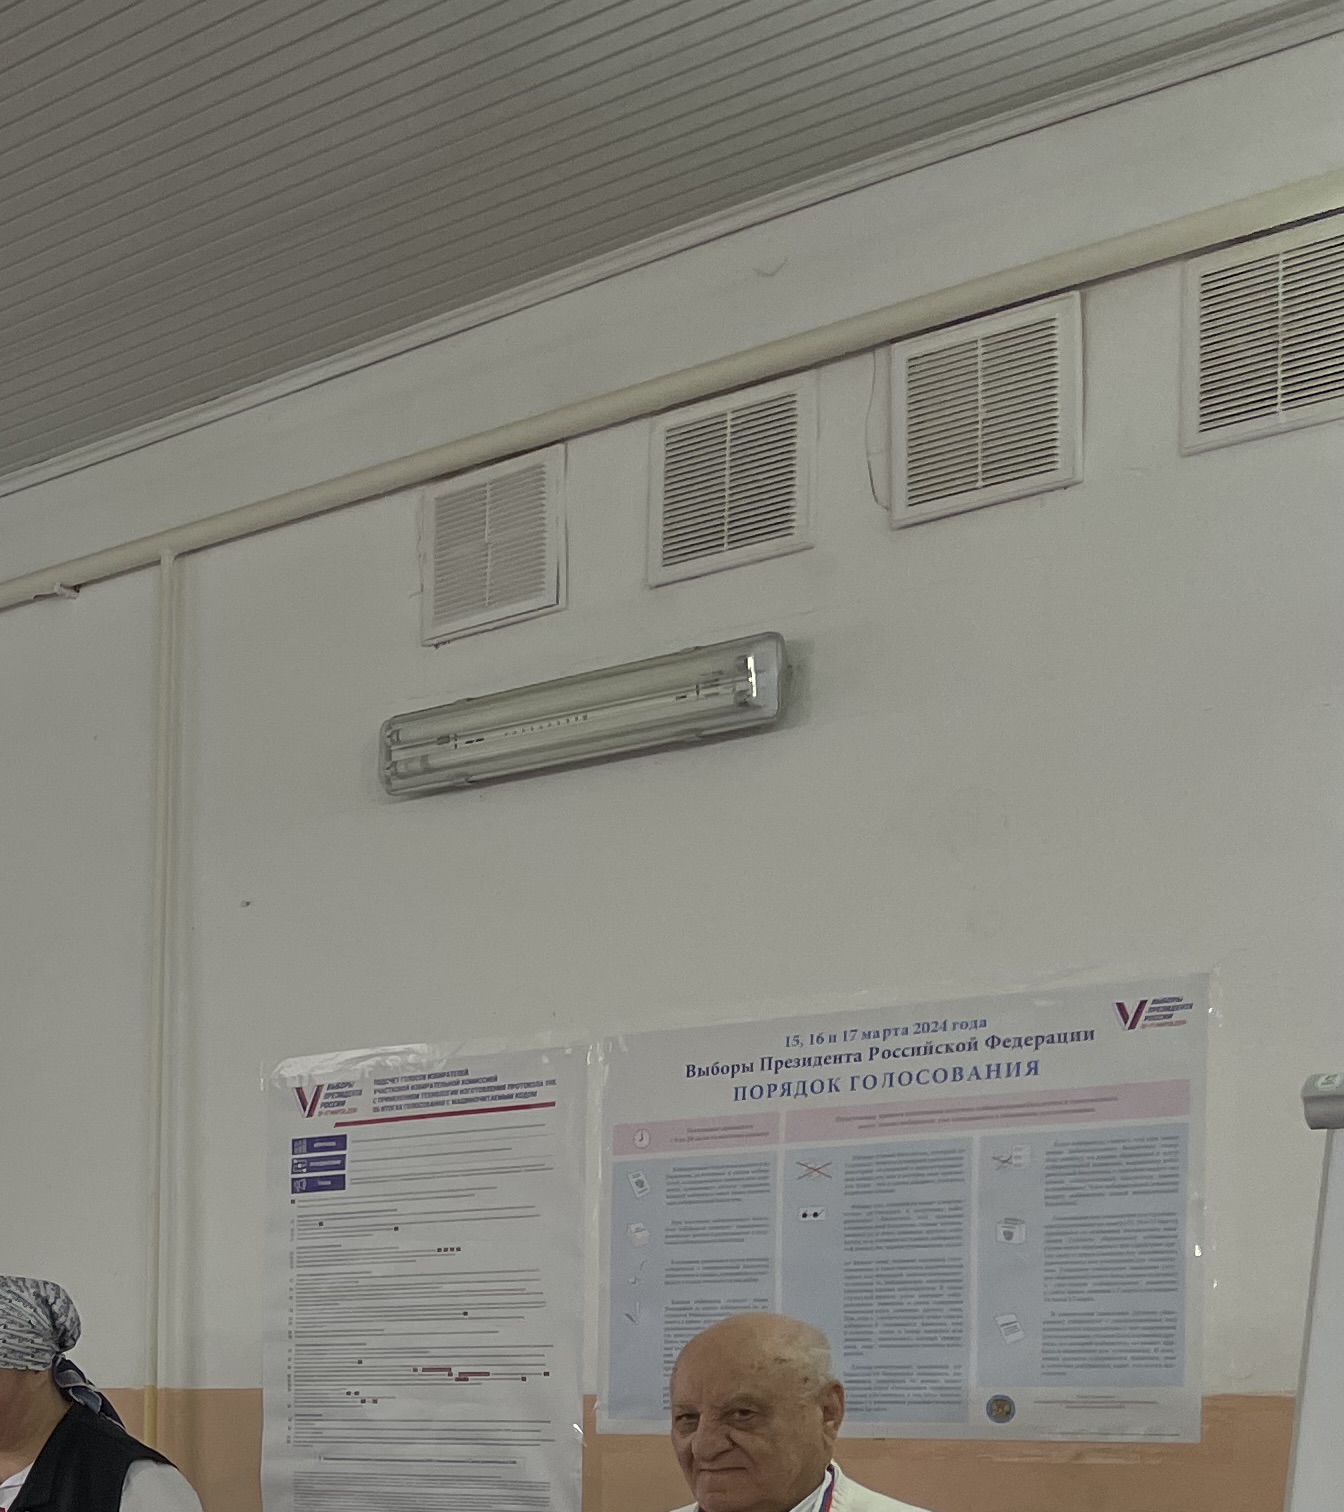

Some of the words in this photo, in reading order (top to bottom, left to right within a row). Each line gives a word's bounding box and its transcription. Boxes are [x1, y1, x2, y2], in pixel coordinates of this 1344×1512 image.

[685, 1060, 755, 1080] Выборы
[760, 1051, 862, 1075] Президента
[869, 1037, 979, 1062] Российской
[984, 1027, 1095, 1053] Федерации
[785, 1035, 804, 1049] 15,
[809, 1032, 824, 1045] 16
[828, 1035, 837, 1044] и
[843, 1030, 858, 1042] 17
[861, 1025, 909, 1043] марта
[913, 1020, 947, 1035] 2024
[952, 1017, 987, 1032] года
[733, 1077, 841, 1101] ПОРЯДОК
[849, 1060, 1041, 1091] ГОЛОСОВАНИЯ
